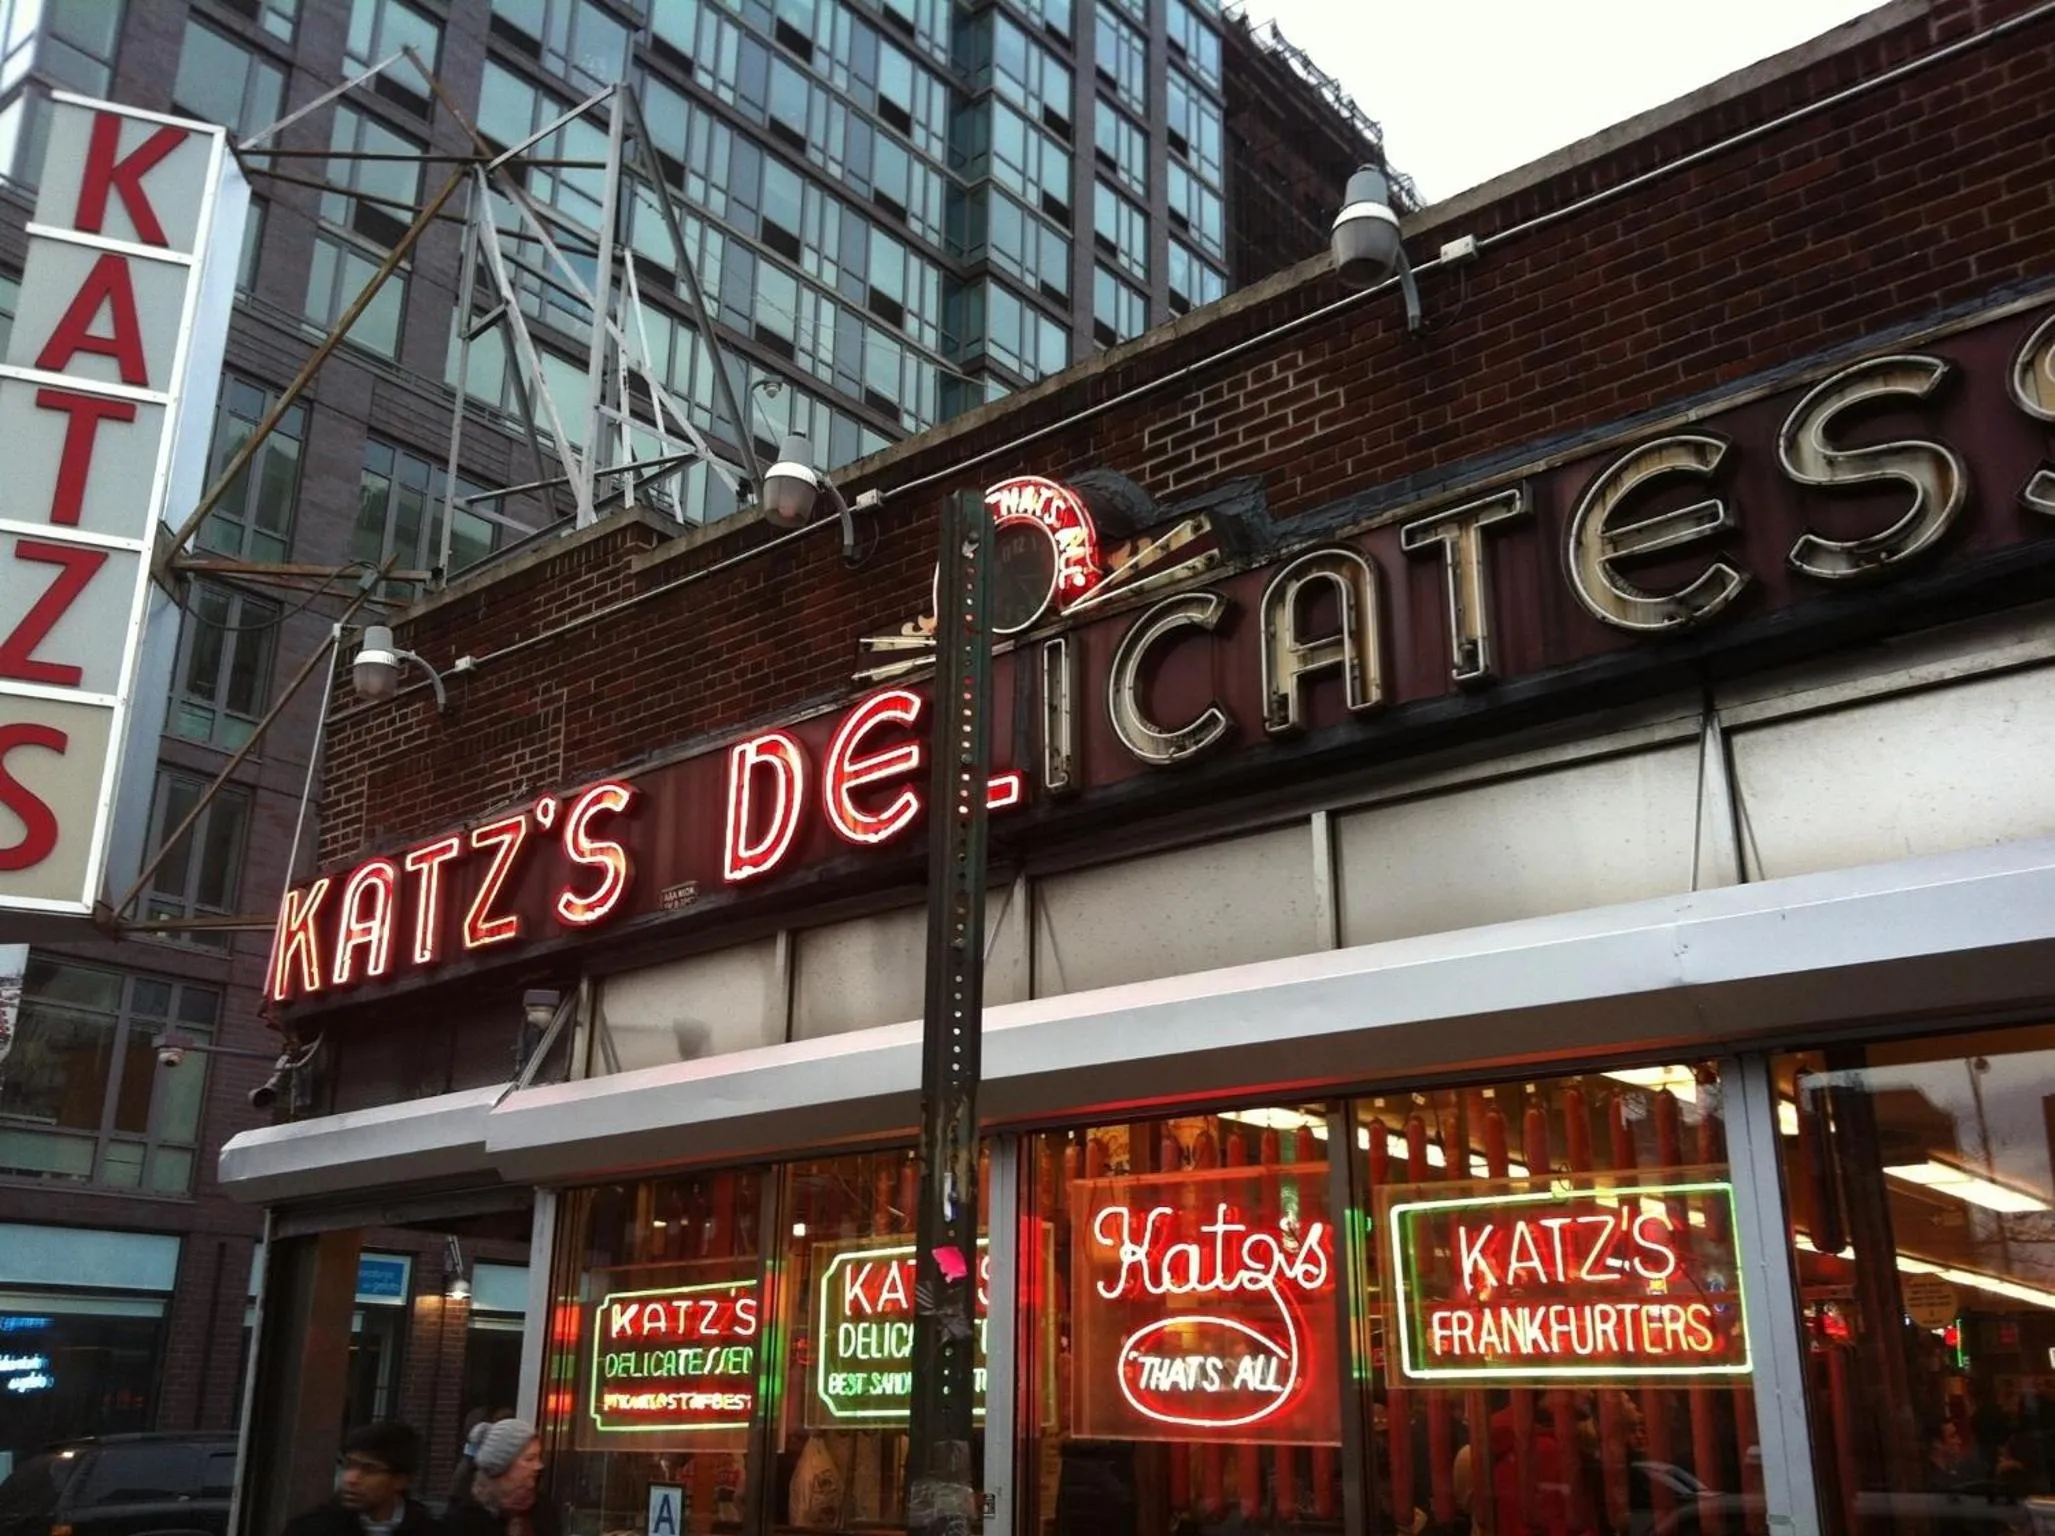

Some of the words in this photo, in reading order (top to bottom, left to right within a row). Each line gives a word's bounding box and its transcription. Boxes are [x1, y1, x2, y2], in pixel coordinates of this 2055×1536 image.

[0, 110, 190, 873] KATZS
[270, 780, 634, 1001] KATZ'S
[1458, 1205, 1676, 1294] KATZ'S
[611, 1287, 758, 1338] KATZ'S
[1431, 1303, 1714, 1356] FRANKFURTERS
[828, 1371, 867, 1396] BEST
[1233, 1353, 1284, 1392] ALL
[653, 1493, 676, 1535] A
